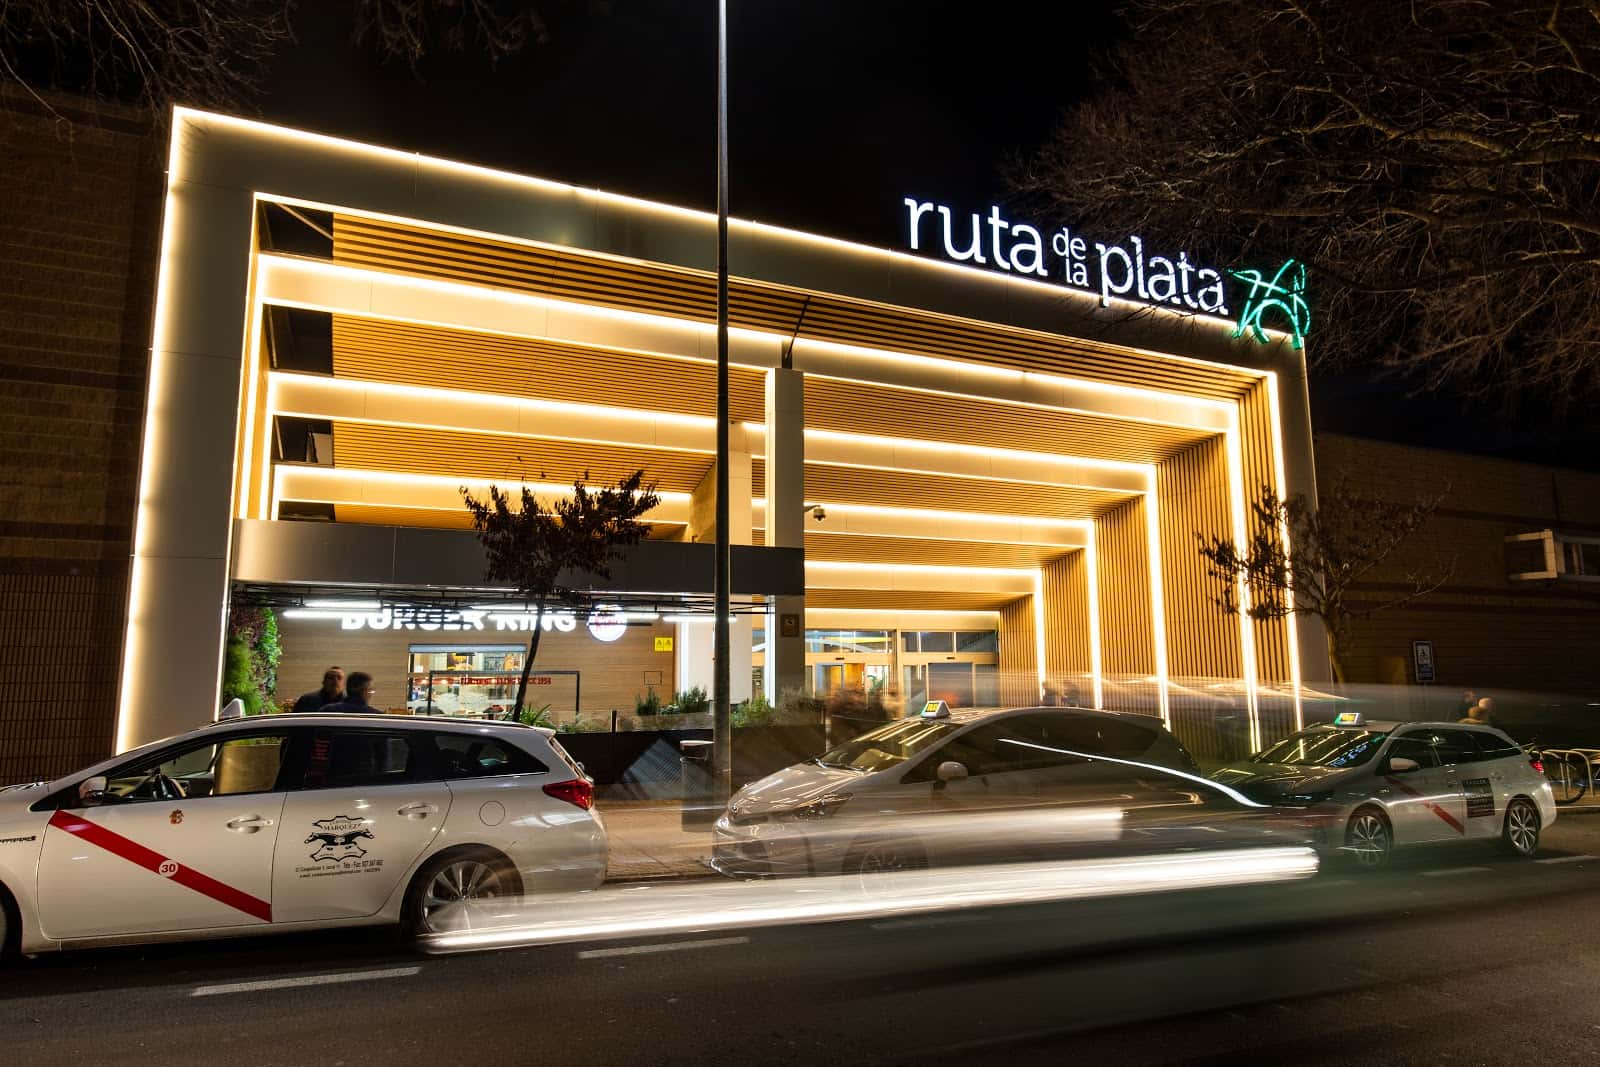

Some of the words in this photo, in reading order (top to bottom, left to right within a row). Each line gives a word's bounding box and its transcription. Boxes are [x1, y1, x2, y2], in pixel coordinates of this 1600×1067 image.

[904, 197, 1048, 277] ruta
[1052, 227, 1087, 260] de
[1065, 256, 1089, 288] la
[1096, 235, 1229, 316] plata
[161, 863, 176, 873] 30
